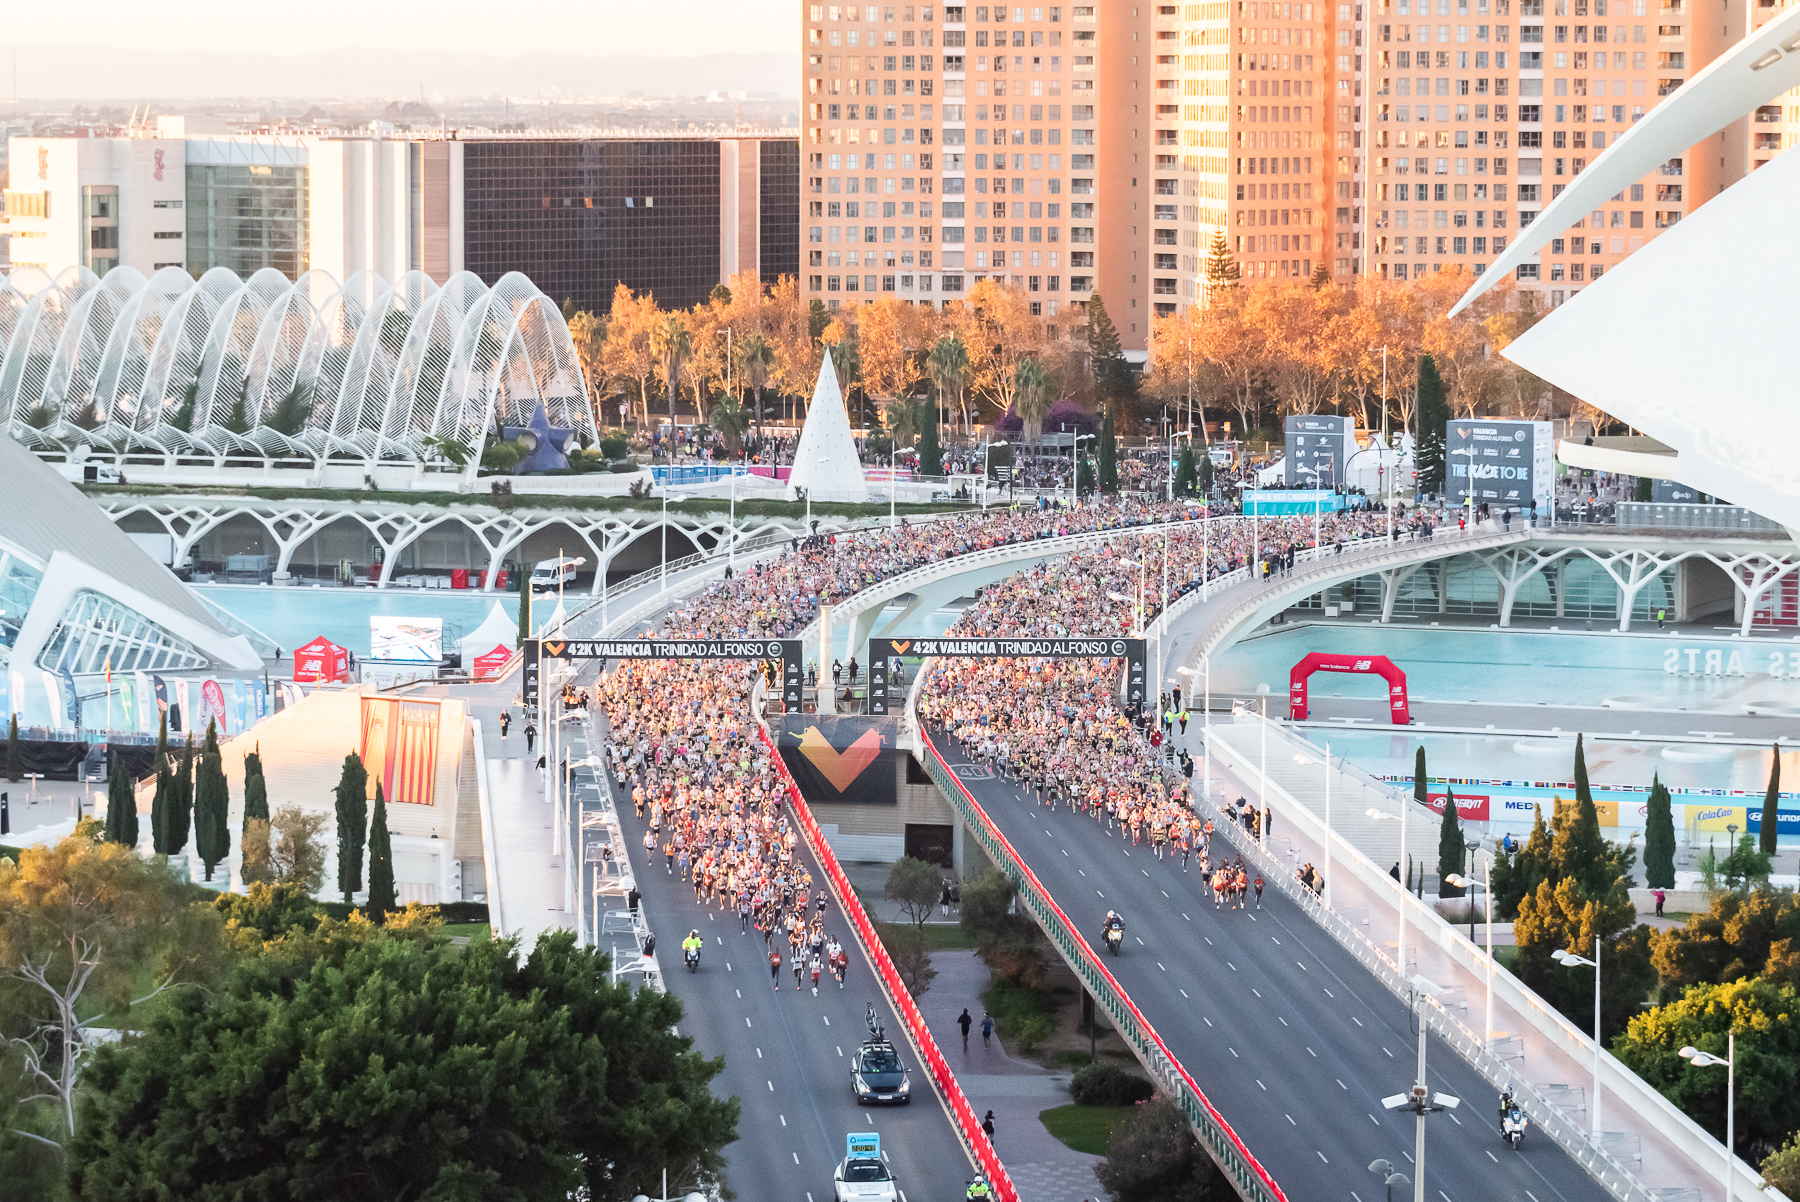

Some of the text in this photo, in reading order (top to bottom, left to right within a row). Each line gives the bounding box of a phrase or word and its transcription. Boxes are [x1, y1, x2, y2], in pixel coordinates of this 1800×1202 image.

[1452, 464, 1467, 477] THE
[1500, 466, 1516, 479] TO
[1517, 467, 1528, 480] BE
[568, 643, 763, 656] 42K VALENCIA TRINIDAD ALFONSO
[913, 641, 1107, 654] 42K VALENCIA TRINIDAD ALFONSO
[1698, 808, 1733, 821] ColaCao
